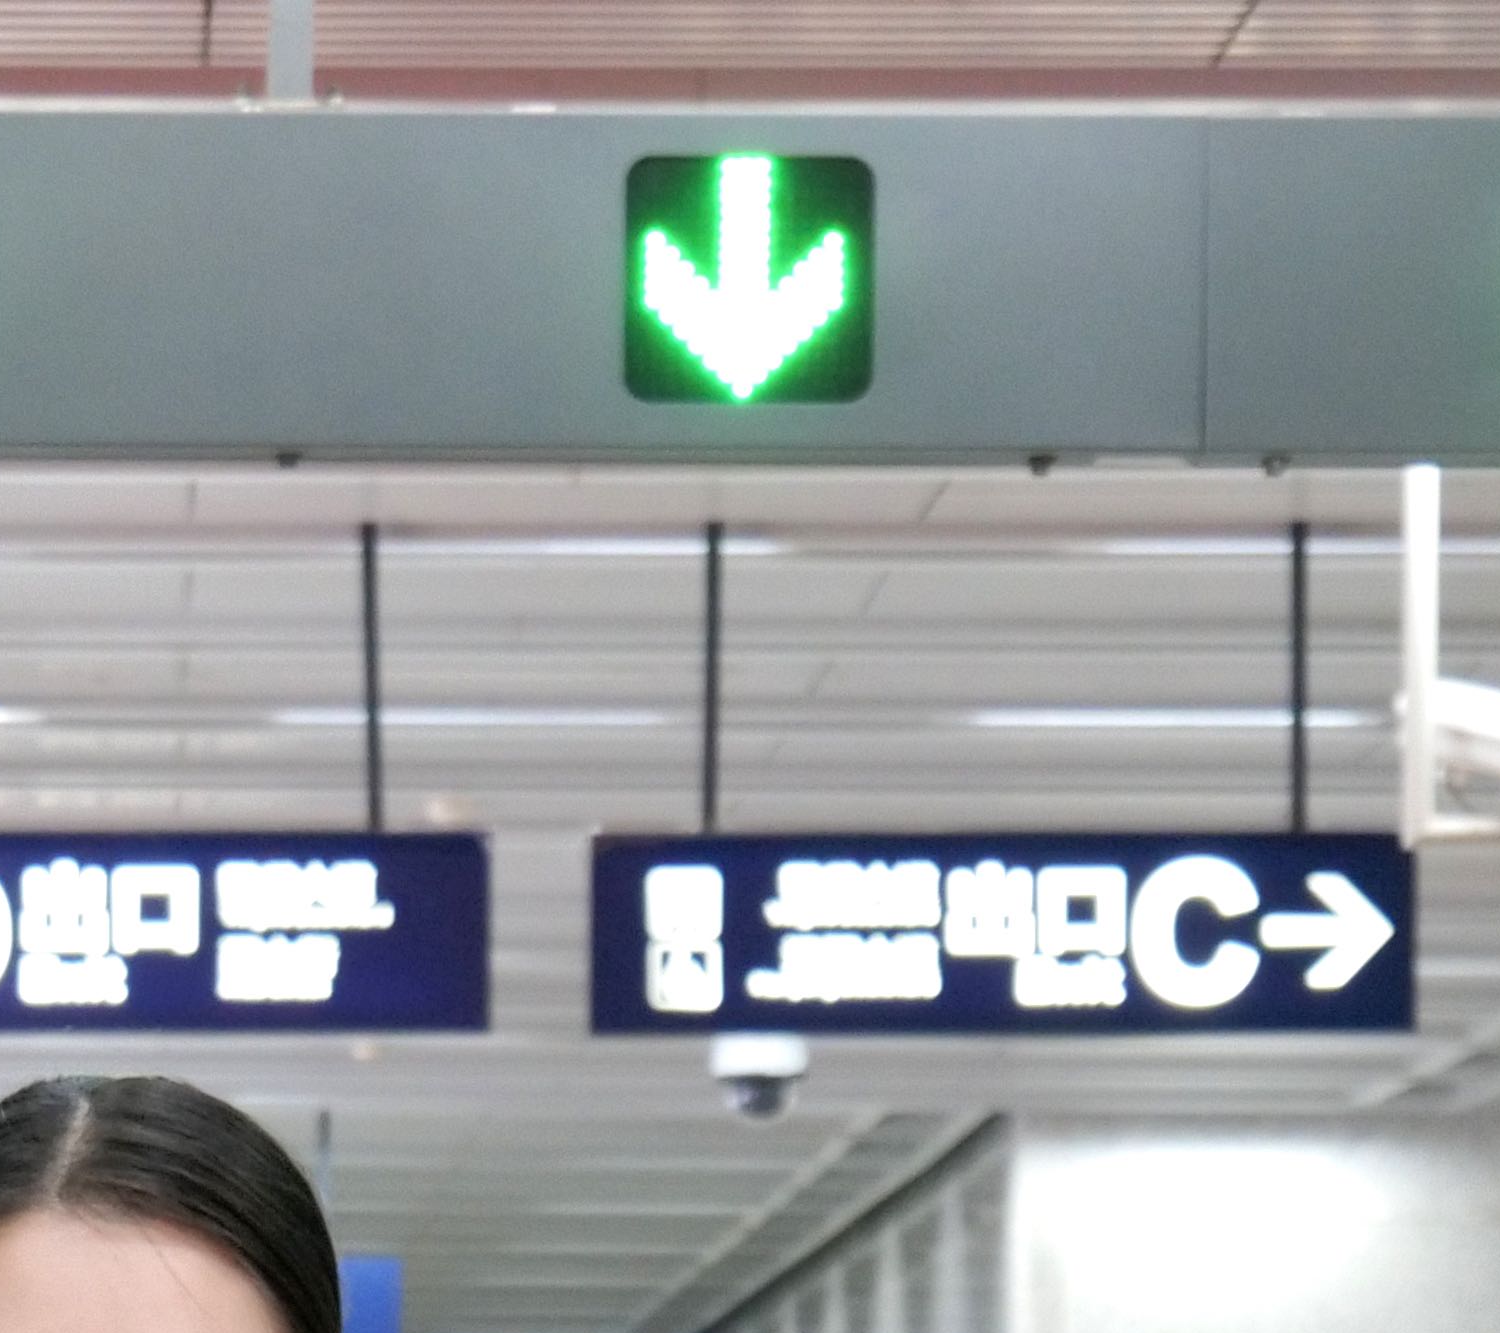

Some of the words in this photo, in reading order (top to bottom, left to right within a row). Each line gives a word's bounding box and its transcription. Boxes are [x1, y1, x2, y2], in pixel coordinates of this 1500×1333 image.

[19, 857, 201, 957] 出口
[944, 858, 1128, 958] 出口
[1130, 854, 1262, 1009] C
